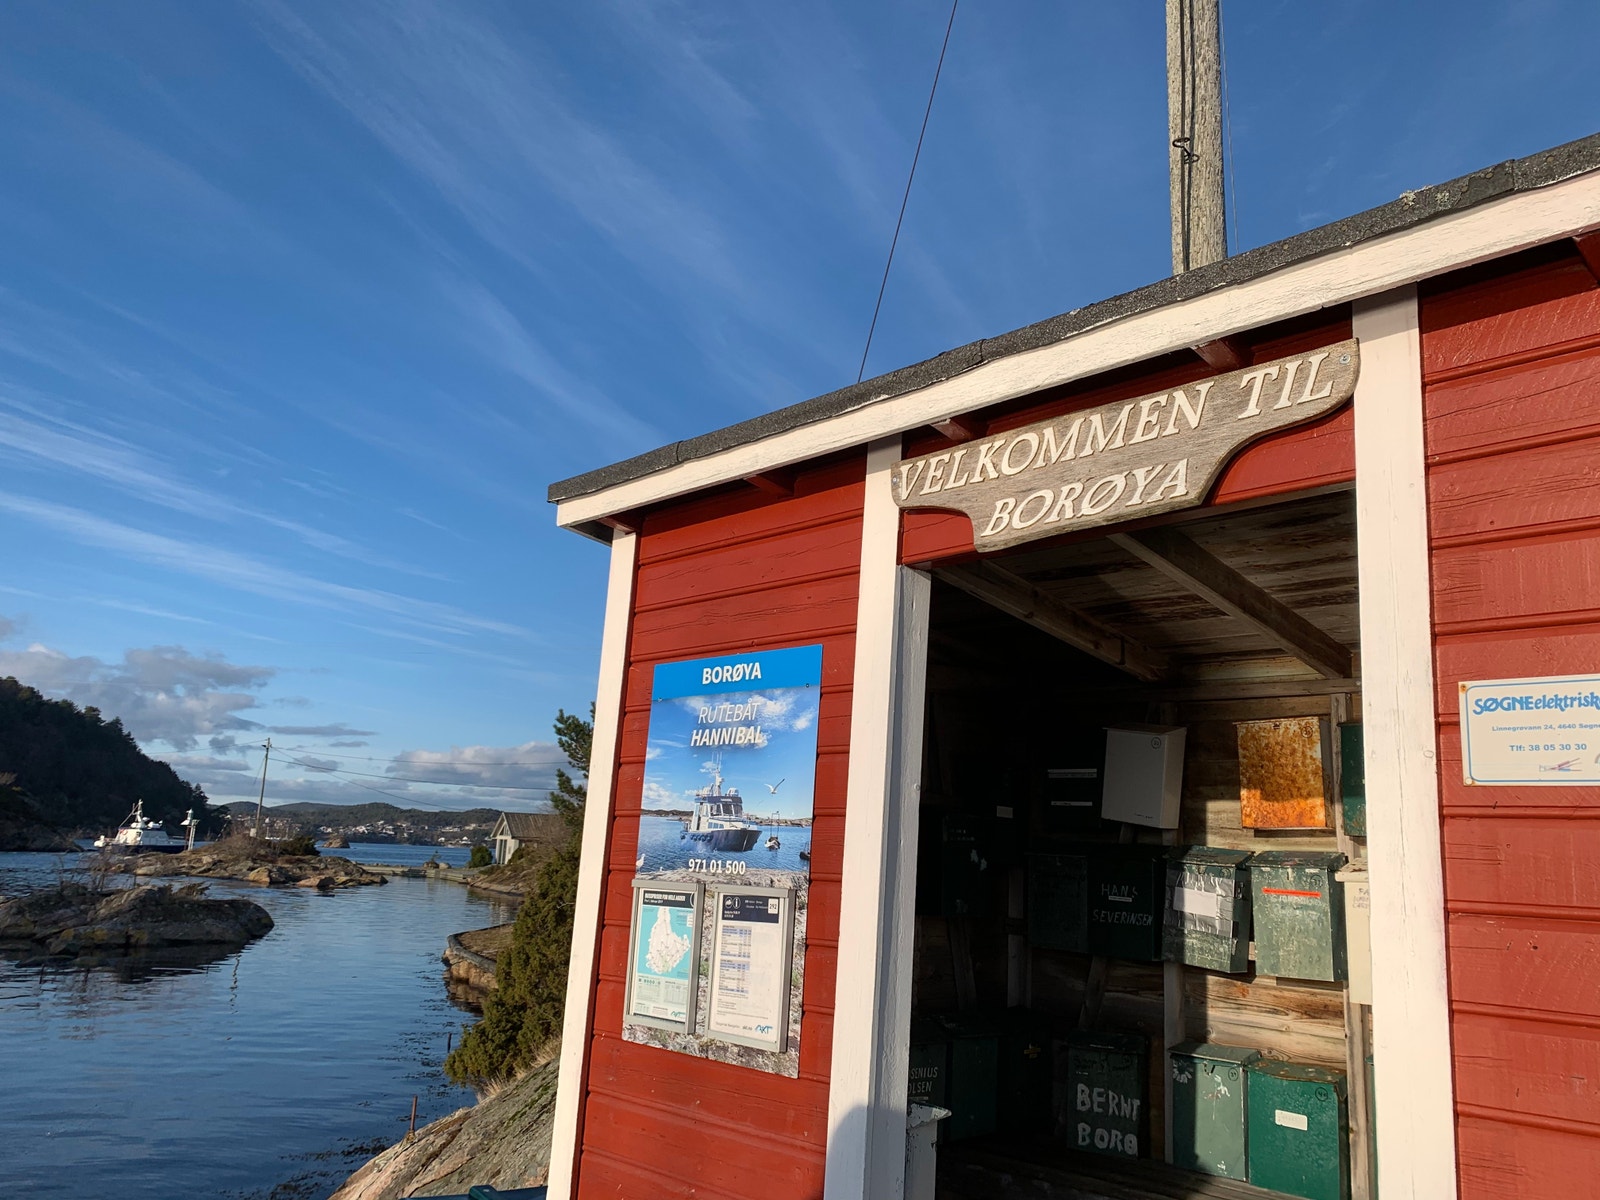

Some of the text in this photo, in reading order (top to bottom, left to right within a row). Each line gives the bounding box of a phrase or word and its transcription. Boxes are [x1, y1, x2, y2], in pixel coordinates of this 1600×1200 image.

[899, 352, 1336, 500] VELKOMMEN TIL
[980, 458, 1190, 537] BORØYA
[702, 661, 762, 685] BORØYA
[698, 698, 762, 724] RUTEBÅT
[690, 726, 763, 747] HANNIBAL
[1543, 743, 1556, 751] 05
[1559, 743, 1571, 751] 30
[1574, 743, 1587, 751] 30
[688, 858, 746, 875] 971 01 500
[1101, 883, 1139, 898] HANS
[1076, 1082, 1141, 1122] BERNT
